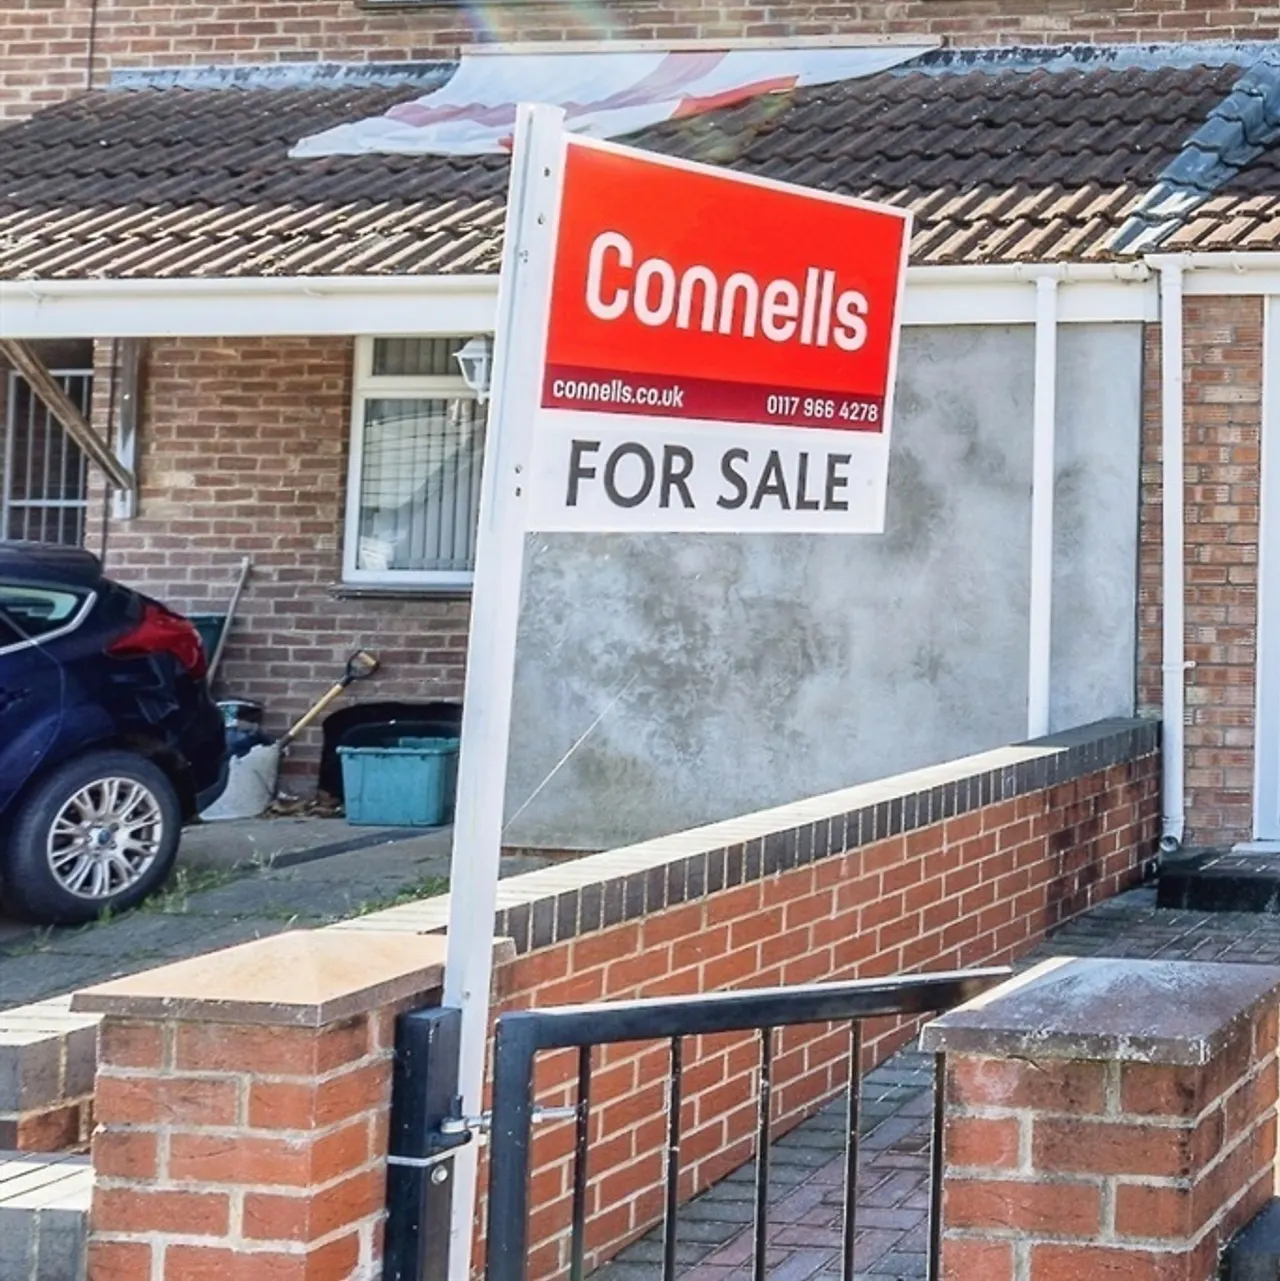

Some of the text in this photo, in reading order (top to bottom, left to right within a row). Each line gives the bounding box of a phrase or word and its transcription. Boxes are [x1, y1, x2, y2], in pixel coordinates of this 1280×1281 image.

[585, 231, 868, 351] Connells
[553, 379, 684, 408] connells.co.uk
[767, 395, 878, 422] 0117 966 4278
[565, 439, 852, 511] FOR SALE
